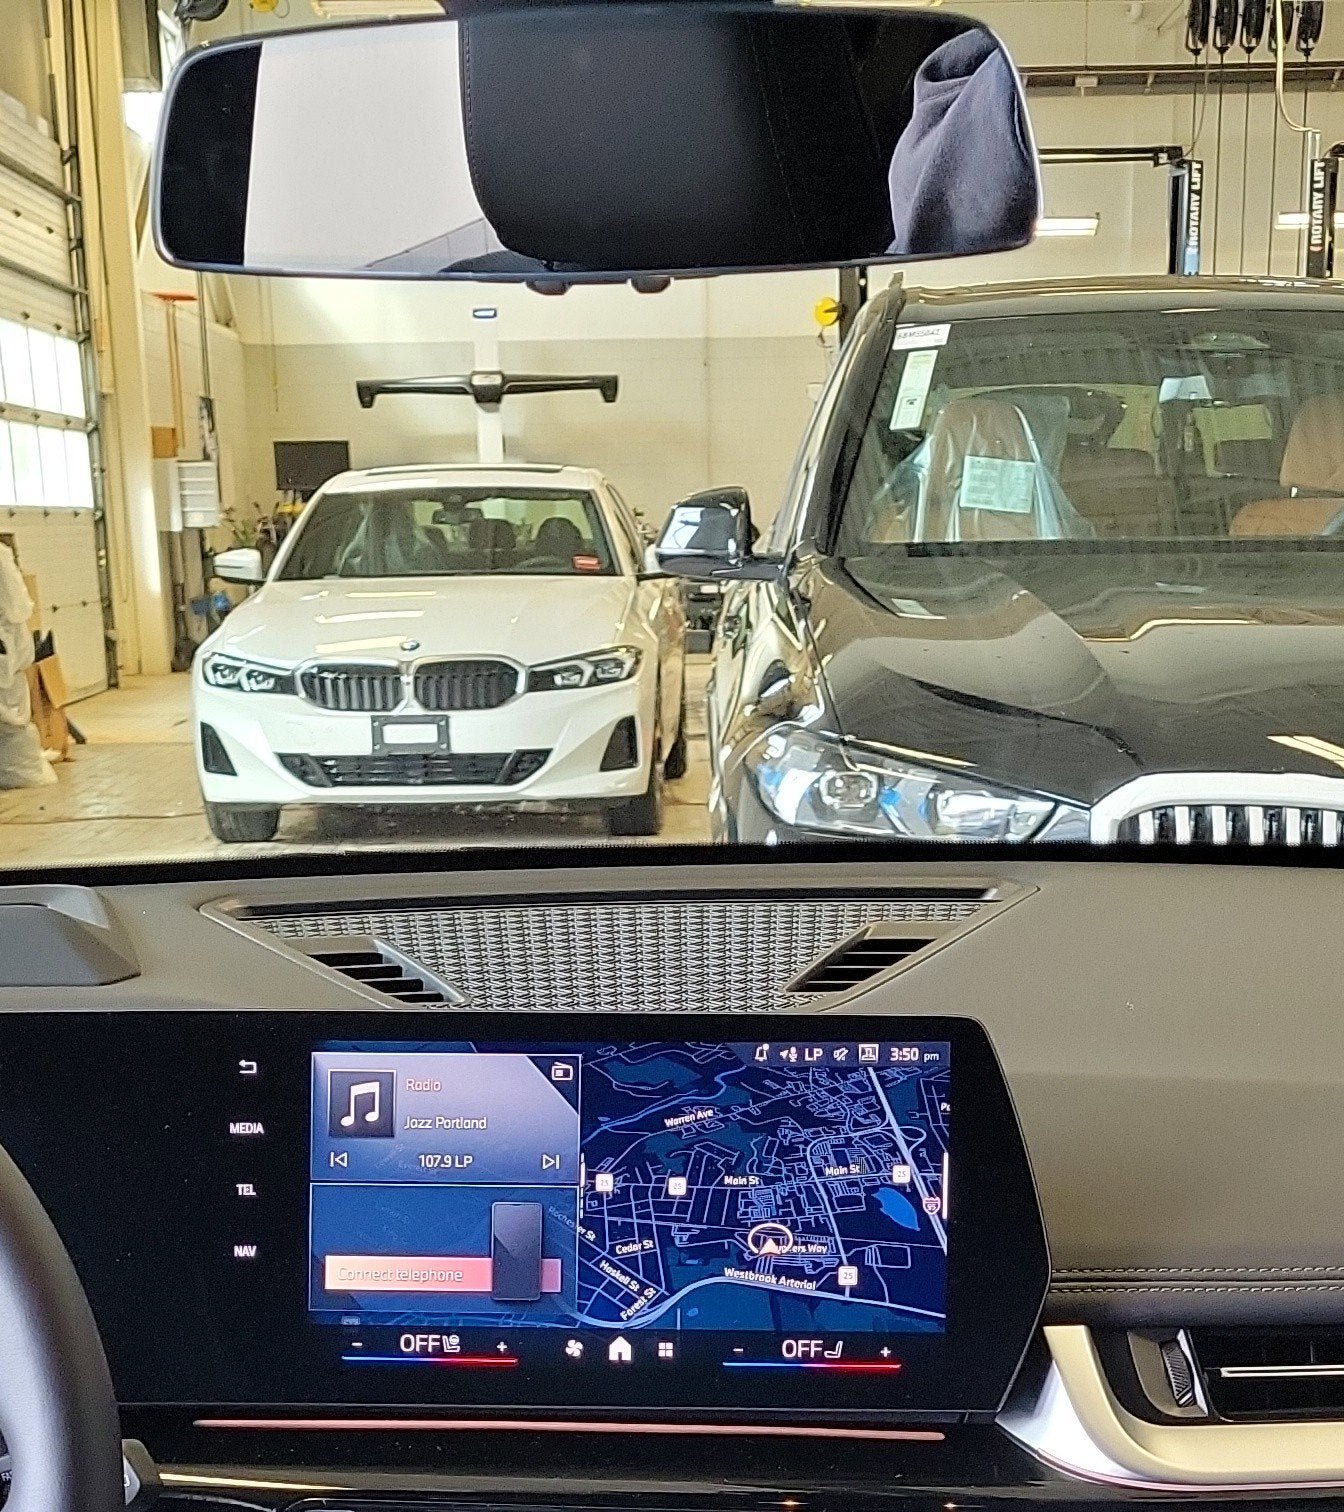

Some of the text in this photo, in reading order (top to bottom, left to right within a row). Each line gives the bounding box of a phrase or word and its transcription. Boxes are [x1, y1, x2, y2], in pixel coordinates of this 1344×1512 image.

[1189, 162, 1202, 246] ROTARY LIFT
[1311, 161, 1325, 244] ROTARY LIFT
[805, 1048, 939, 1063] LP 3:50 pm
[406, 1078, 442, 1092] Radio
[404, 1116, 487, 1131] Jazz Portland
[664, 1108, 714, 1129] Warren Ave
[229, 1122, 264, 1135] MEDIA
[418, 1154, 452, 1168] 107.9
[455, 1154, 473, 1168] LP
[825, 1164, 860, 1178] Main St
[724, 1176, 760, 1187] Main St
[236, 1184, 256, 1196] TEL
[585, 1230, 596, 1242] St
[234, 1245, 256, 1257] NAV
[616, 1239, 654, 1255] Cedar St
[807, 1244, 827, 1255] Way
[337, 1267, 463, 1284] Connect telephone
[599, 1259, 640, 1293] Haskell St
[724, 1267, 816, 1291] Westbrook Arterial
[620, 1286, 656, 1321] Forest St
[400, 1333, 440, 1352] OFF
[782, 1339, 823, 1358] OFF
